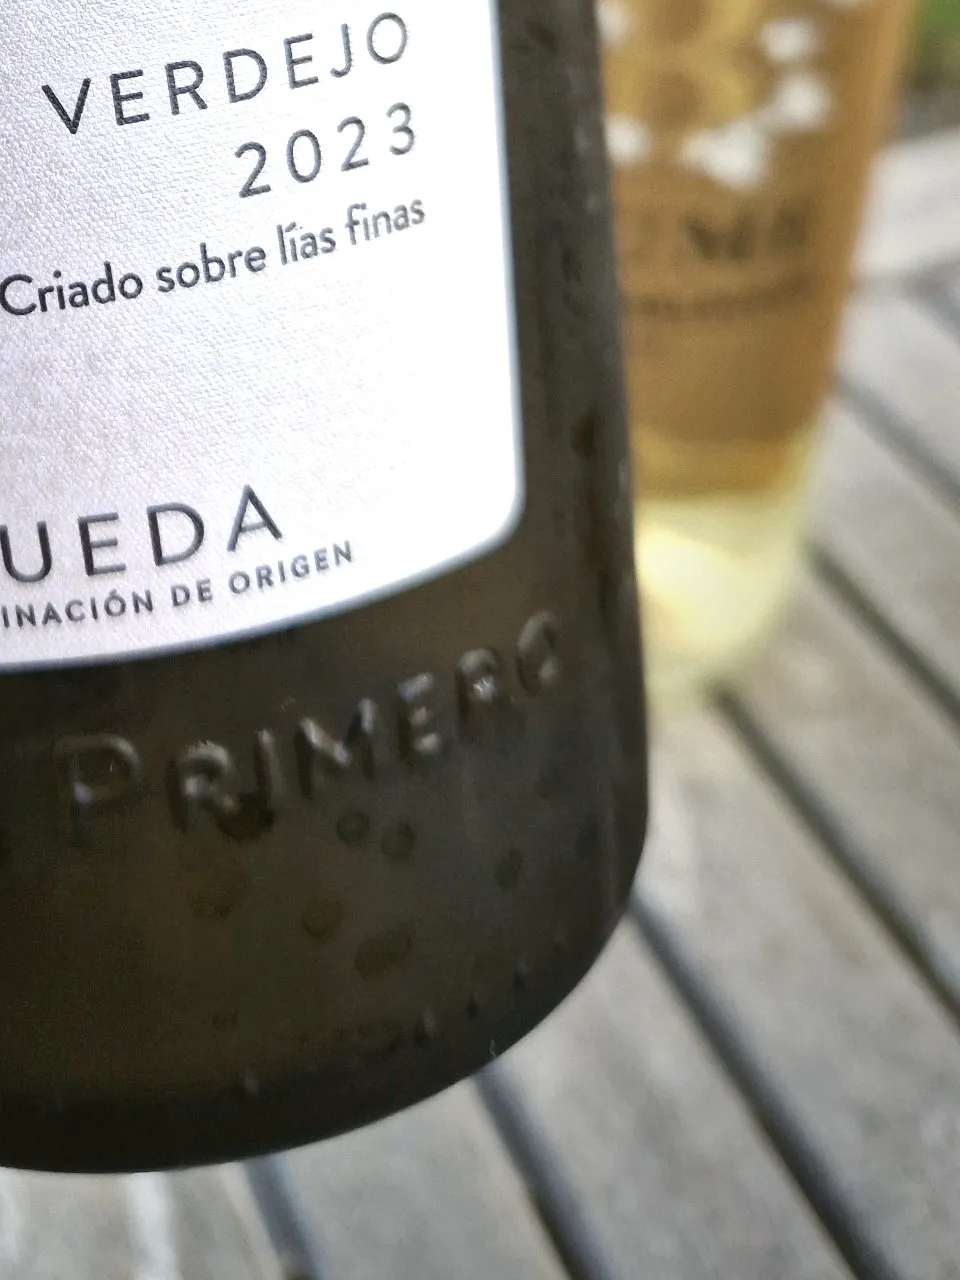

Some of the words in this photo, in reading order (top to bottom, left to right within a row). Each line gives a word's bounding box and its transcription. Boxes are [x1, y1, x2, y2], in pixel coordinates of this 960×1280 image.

[41, 11, 409, 135] VERDEJO
[234, 101, 416, 199] 2023
[155, 242, 267, 293] sobre
[276, 220, 337, 266] lías
[344, 199, 426, 246] finas
[170, 579, 212, 608] DE
[228, 540, 353, 596] ORIGEN
[50, 609, 562, 848] PRIMERO
